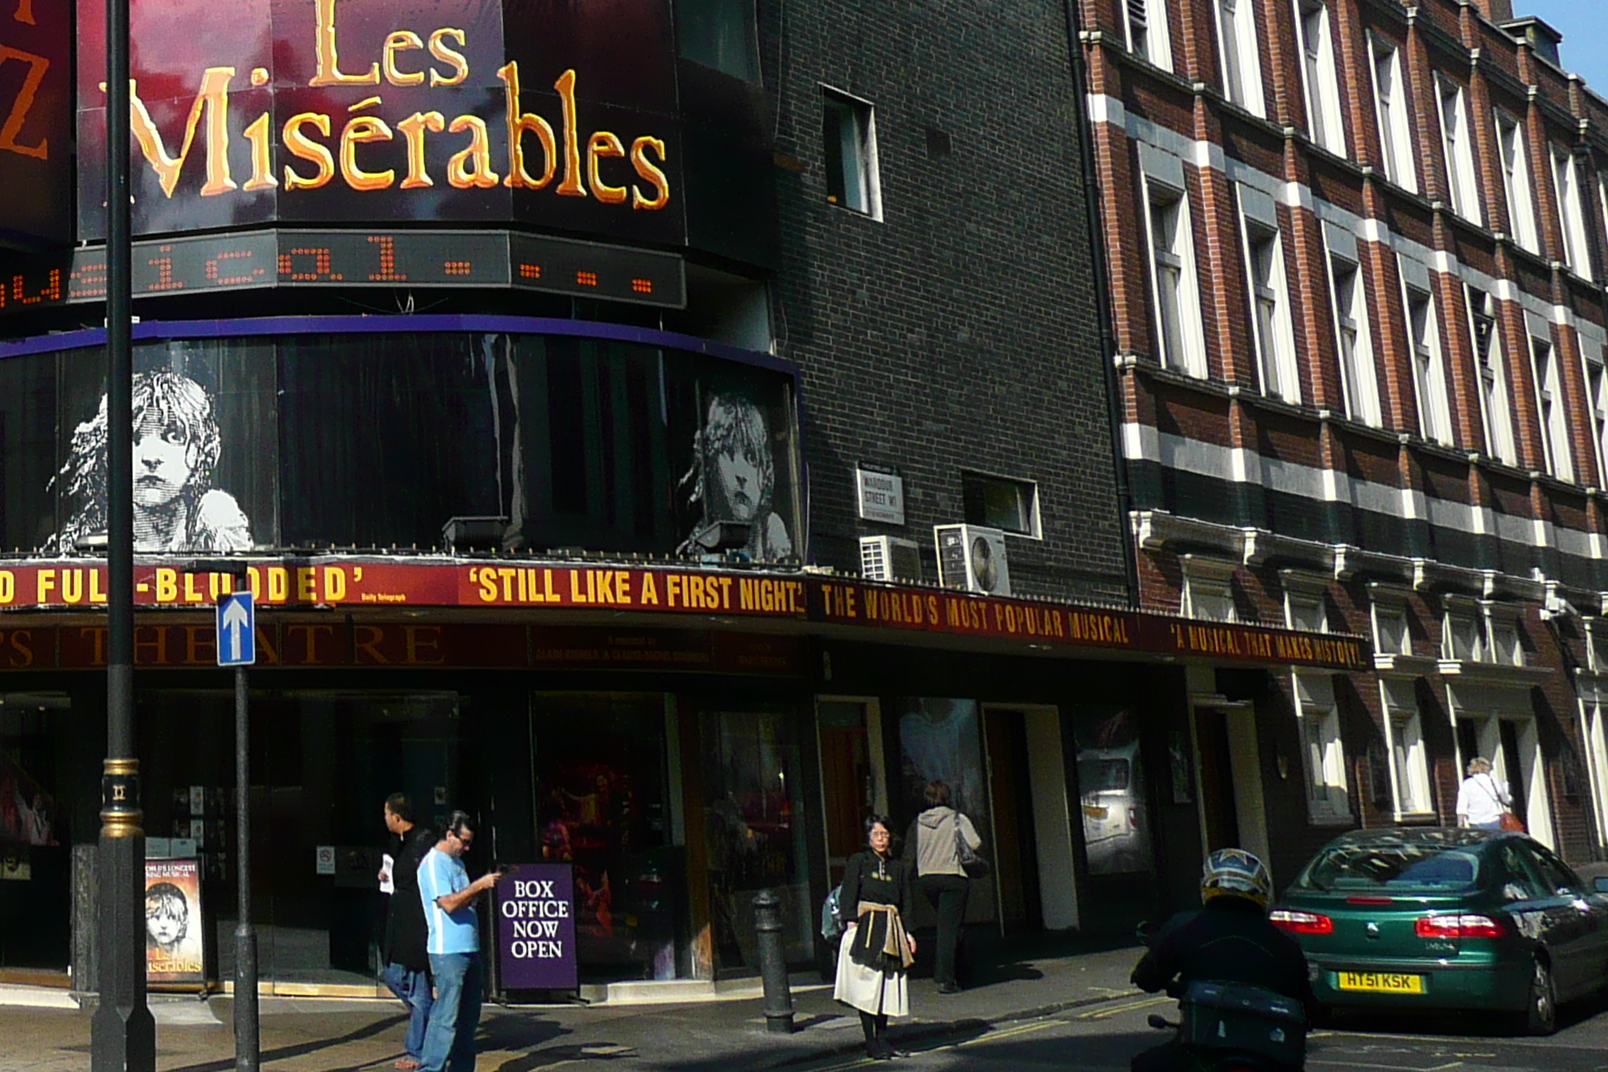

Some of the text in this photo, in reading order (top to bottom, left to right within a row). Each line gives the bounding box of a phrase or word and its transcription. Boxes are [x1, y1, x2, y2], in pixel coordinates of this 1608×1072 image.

[99, 60, 672, 211] Misérables
[864, 491, 886, 506] STREET
[37, 566, 363, 603] FUL-BLOODED'
[570, 569, 632, 606] LIKE
[641, 572, 659, 606] A
[666, 574, 732, 610] FIRST
[821, 584, 1130, 644] THE WORLD'S MOST POPULAR MUSICAL
[1188, 625, 1241, 656] MUSICAL
[1244, 631, 1273, 658] THAT
[1275, 635, 1313, 661] MAKES
[514, 880, 554, 898] BOX
[502, 900, 569, 918] OFFICE
[513, 920, 559, 938] NOW
[511, 940, 563, 959] OPEN
[1382, 973, 1411, 989] KSK
